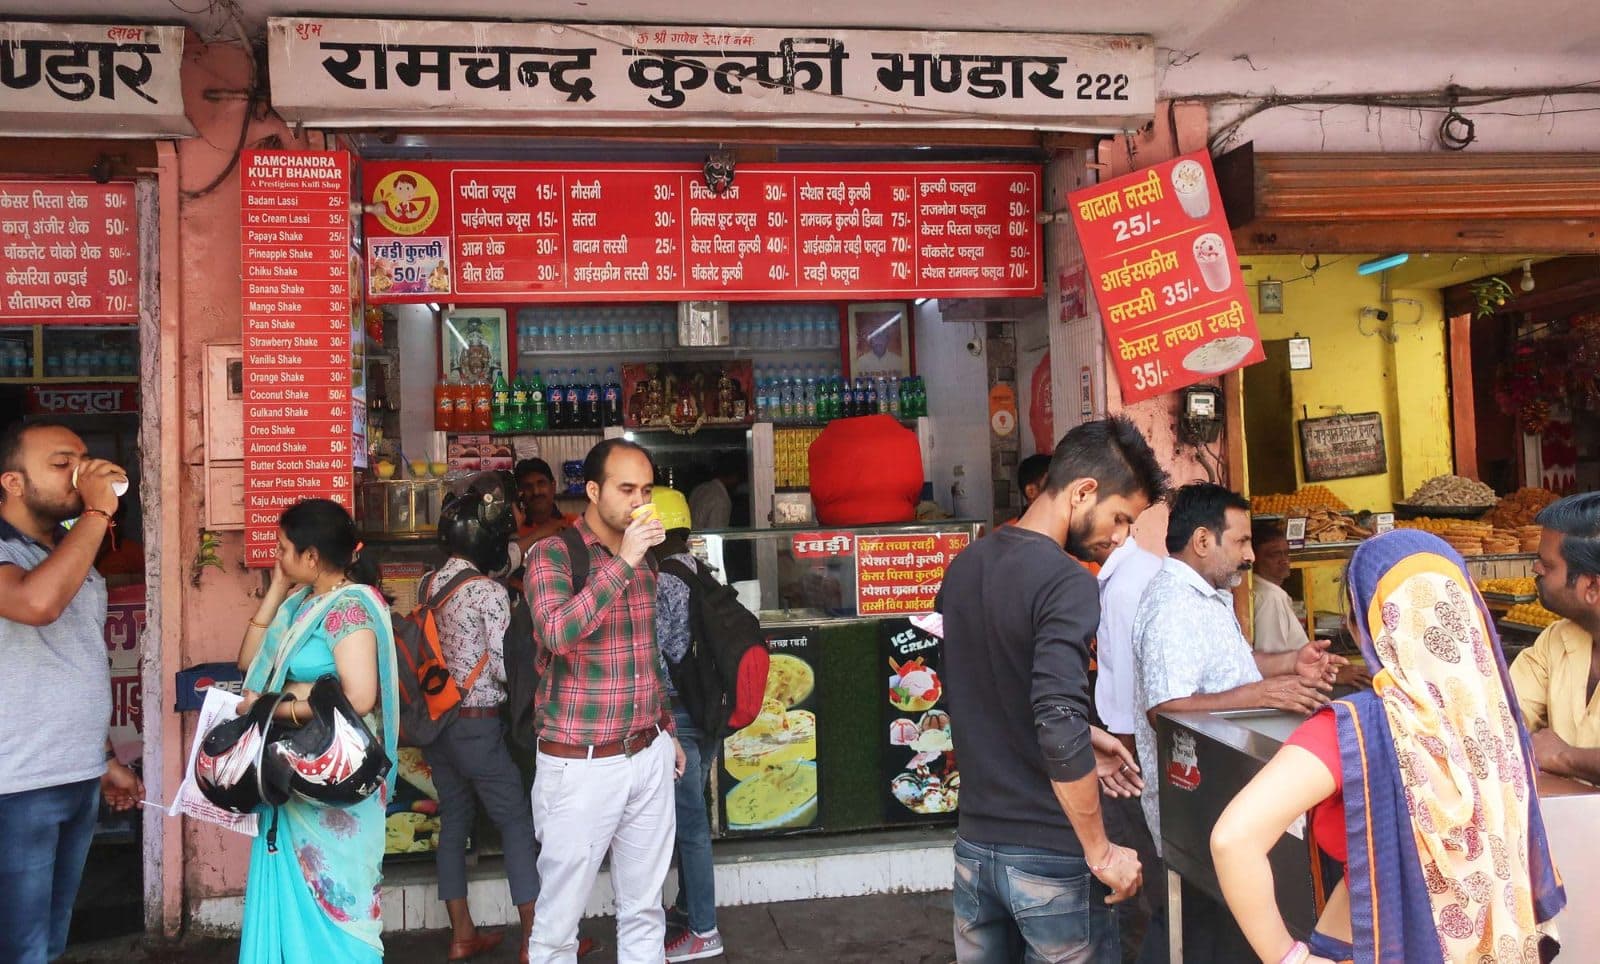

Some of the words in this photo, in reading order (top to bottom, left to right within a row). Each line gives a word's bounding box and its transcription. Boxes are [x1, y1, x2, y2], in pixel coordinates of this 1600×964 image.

[107, 26, 144, 41] लाभ
[0, 39, 161, 104] ण्डार
[320, 42, 597, 102] रामचन्द्र
[622, 37, 850, 108] कुल्फी
[871, 51, 1068, 99] भण्डार
[1076, 73, 1129, 101] 222
[254, 155, 336, 167] RAMCHANDRA
[248, 167, 283, 178] KULFI
[286, 168, 342, 179] BHANDAR
[258, 180, 299, 188] Prestigious
[301, 180, 320, 188] Kulfi
[321, 181, 341, 190] Shop
[536, 184, 557, 200] 15/-
[1009, 181, 1030, 194] 40/-
[654, 185, 675, 200] 30/-
[1077, 190, 1122, 222] बादाम
[1123, 170, 1164, 209] लस्सी
[105, 193, 127, 208] 50/-
[248, 195, 275, 205] Badam
[277, 196, 298, 206] Lassi
[329, 197, 344, 206] 25/-
[1009, 201, 1030, 216] 50/-
[248, 213, 259, 223] Ice
[262, 213, 287, 223] Cream
[289, 214, 310, 223] Lassi
[329, 215, 344, 224] 35/-
[536, 211, 558, 227] 15/-
[655, 212, 676, 227] 30/-
[105, 218, 129, 235] 50/-
[1112, 211, 1161, 243] 25/-
[248, 231, 277, 242] Papaya
[279, 231, 303, 240] Shake
[329, 232, 344, 241] 25/-
[536, 238, 558, 255] 30/-
[655, 238, 676, 254] 25/-
[767, 238, 788, 254] 40/-
[249, 248, 287, 260] Pineapple
[289, 249, 313, 258] Shake
[329, 249, 345, 259] 30/-
[108, 269, 133, 286] 50/-
[249, 266, 271, 276] Chiku
[274, 267, 298, 276] Shake
[329, 267, 345, 276] 30/-
[394, 266, 426, 282] 50/-
[656, 265, 677, 281] 35/-
[891, 262, 911, 279] 70/-
[1100, 249, 1179, 292] आईसक्रीम
[249, 284, 279, 293] Banana
[280, 284, 304, 293] Shake
[329, 285, 345, 294] 30/-
[106, 295, 133, 311] 70/-
[249, 302, 275, 313] Mango
[278, 302, 302, 311] Shake
[329, 302, 345, 311] 30/-
[1107, 287, 1158, 324] लस्सी
[1162, 278, 1200, 306] 35/-
[249, 319, 269, 329] Paan
[271, 319, 295, 329] Shake
[329, 320, 345, 329] 30/-
[1118, 334, 1160, 361] केसर
[1162, 319, 1204, 349] लच्छा
[1206, 300, 1246, 334] रबड़ी
[250, 337, 292, 348] Strawberry
[294, 337, 318, 346] Shake
[330, 337, 346, 346] 30/-
[250, 354, 276, 364] Vanilla
[278, 354, 302, 364] Shake
[330, 354, 346, 364] 30/-
[250, 372, 278, 383] Orange
[280, 372, 304, 381] Shake
[330, 372, 346, 381] 30/-
[1131, 359, 1169, 391] 35/-
[250, 390, 283, 400] Coconut
[285, 390, 309, 399] Shake
[329, 390, 345, 400] 50/-
[250, 408, 282, 417] Gulkand
[284, 407, 308, 417] Shake
[330, 407, 346, 416] 40/-
[250, 425, 269, 435] Oreo
[271, 425, 296, 435] Shake
[331, 425, 346, 433] 40/-
[250, 443, 280, 452] Almond
[282, 442, 307, 452] Shake
[331, 441, 347, 452] 50/-
[250, 460, 274, 470] Butter
[276, 460, 303, 470] Scotch
[305, 460, 329, 469] Shake
[331, 459, 347, 469] 40/-
[251, 478, 273, 488] Kesar
[275, 478, 295, 487] Pista
[297, 477, 321, 487] Shake
[332, 476, 349, 487] 50/-
[251, 496, 269, 507] Kaju
[270, 496, 296, 507] Anjeer
[251, 513, 279, 523] Chocol
[252, 531, 277, 541] Sitafal
[252, 549, 268, 558] Kivi
[891, 628, 916, 647] ICE
